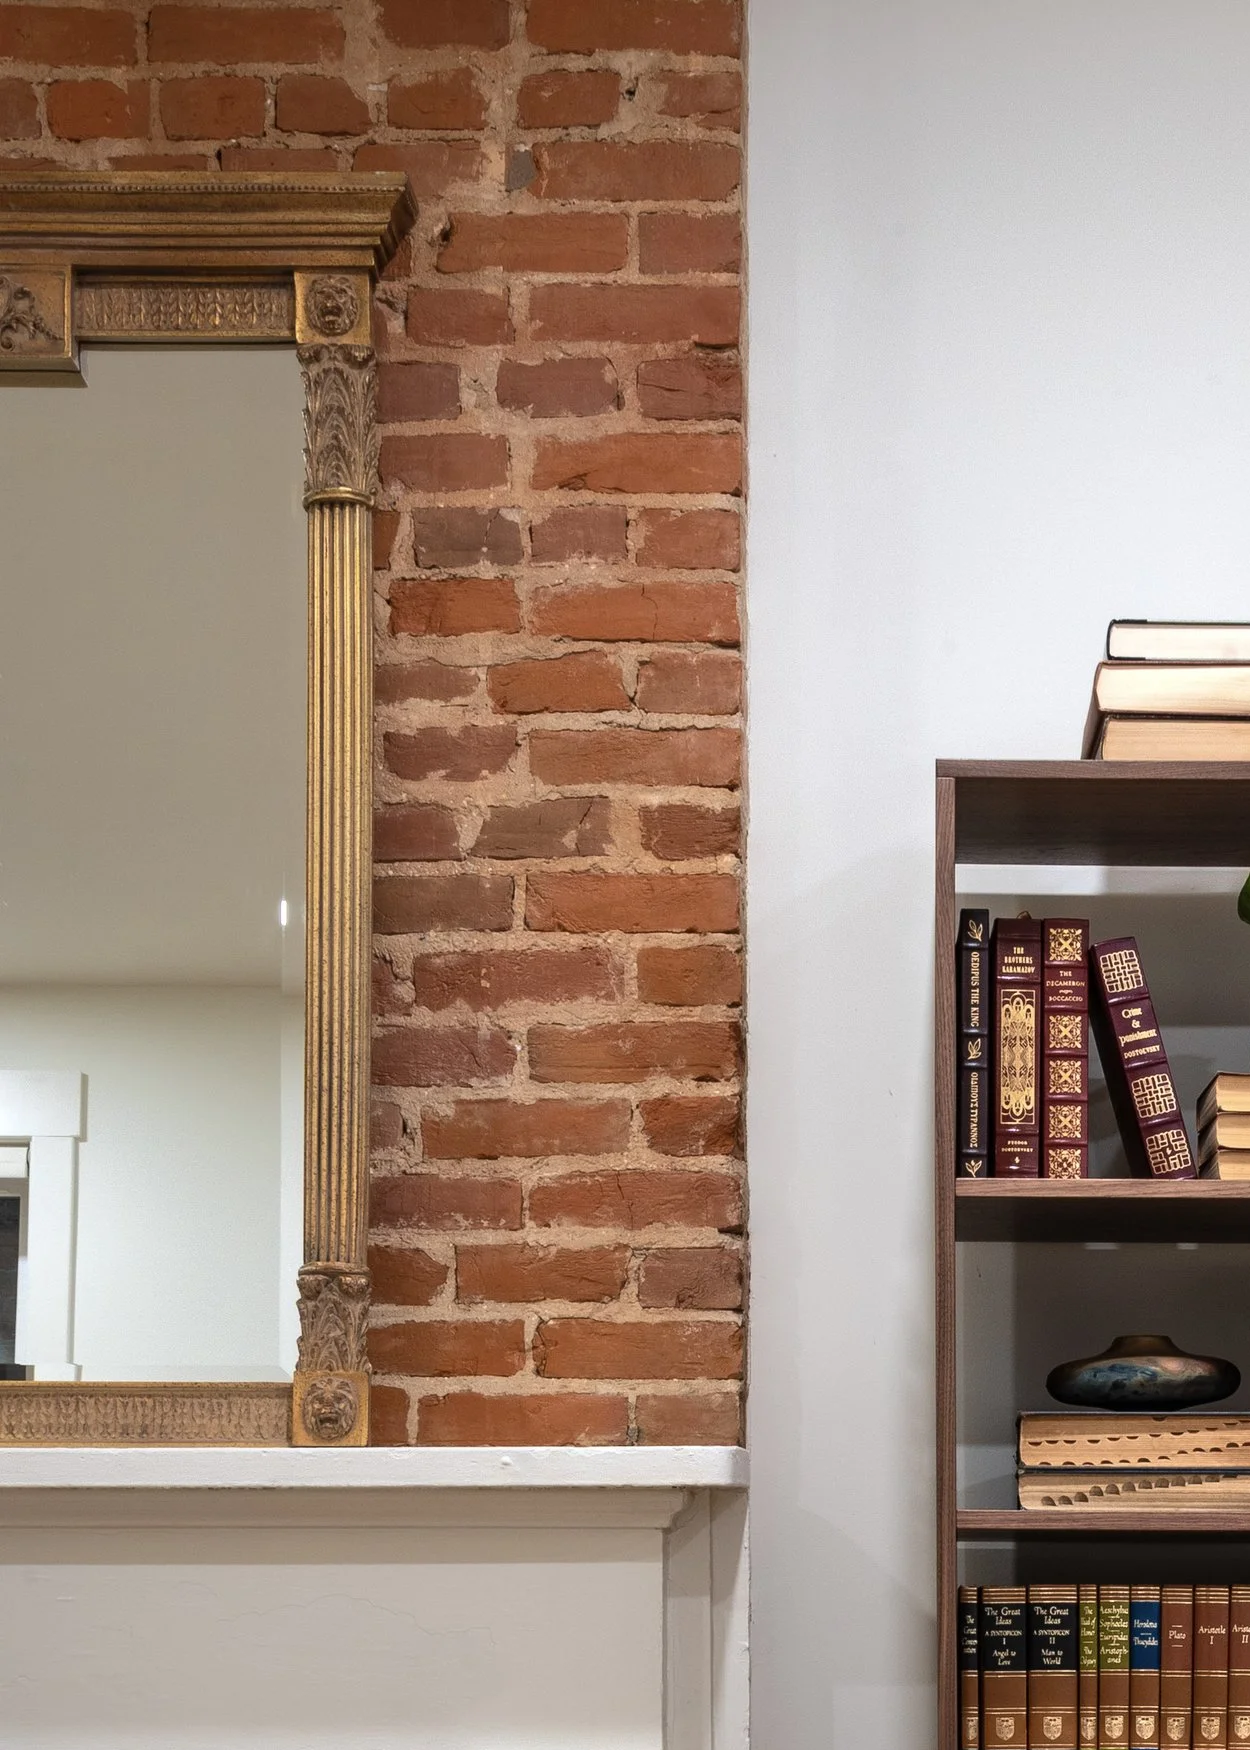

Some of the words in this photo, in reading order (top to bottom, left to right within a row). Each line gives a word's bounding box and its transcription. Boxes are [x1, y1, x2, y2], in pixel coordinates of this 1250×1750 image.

[1004, 956, 1033, 964] BROTHERS
[971, 952, 980, 986] OEDIPUS
[1002, 966, 1036, 974] KARAMAZOV
[971, 988, 980, 1005] THE
[970, 1007, 980, 1028] KING
[1131, 1019, 1141, 1028] &
[1123, 1045, 1160, 1059] DOSTOEVSKY
[984, 1607, 998, 1616] The
[1001, 1606, 1021, 1616] Great
[1034, 1607, 1047, 1616] The
[1050, 1606, 1069, 1616] Great
[995, 1616, 1012, 1625] Ideas
[1044, 1616, 1061, 1625] Ideas
[1168, 1630, 1186, 1640] Plato
[1198, 1625, 1226, 1635] Aristotle
[1241, 1635, 1249, 1644] II
